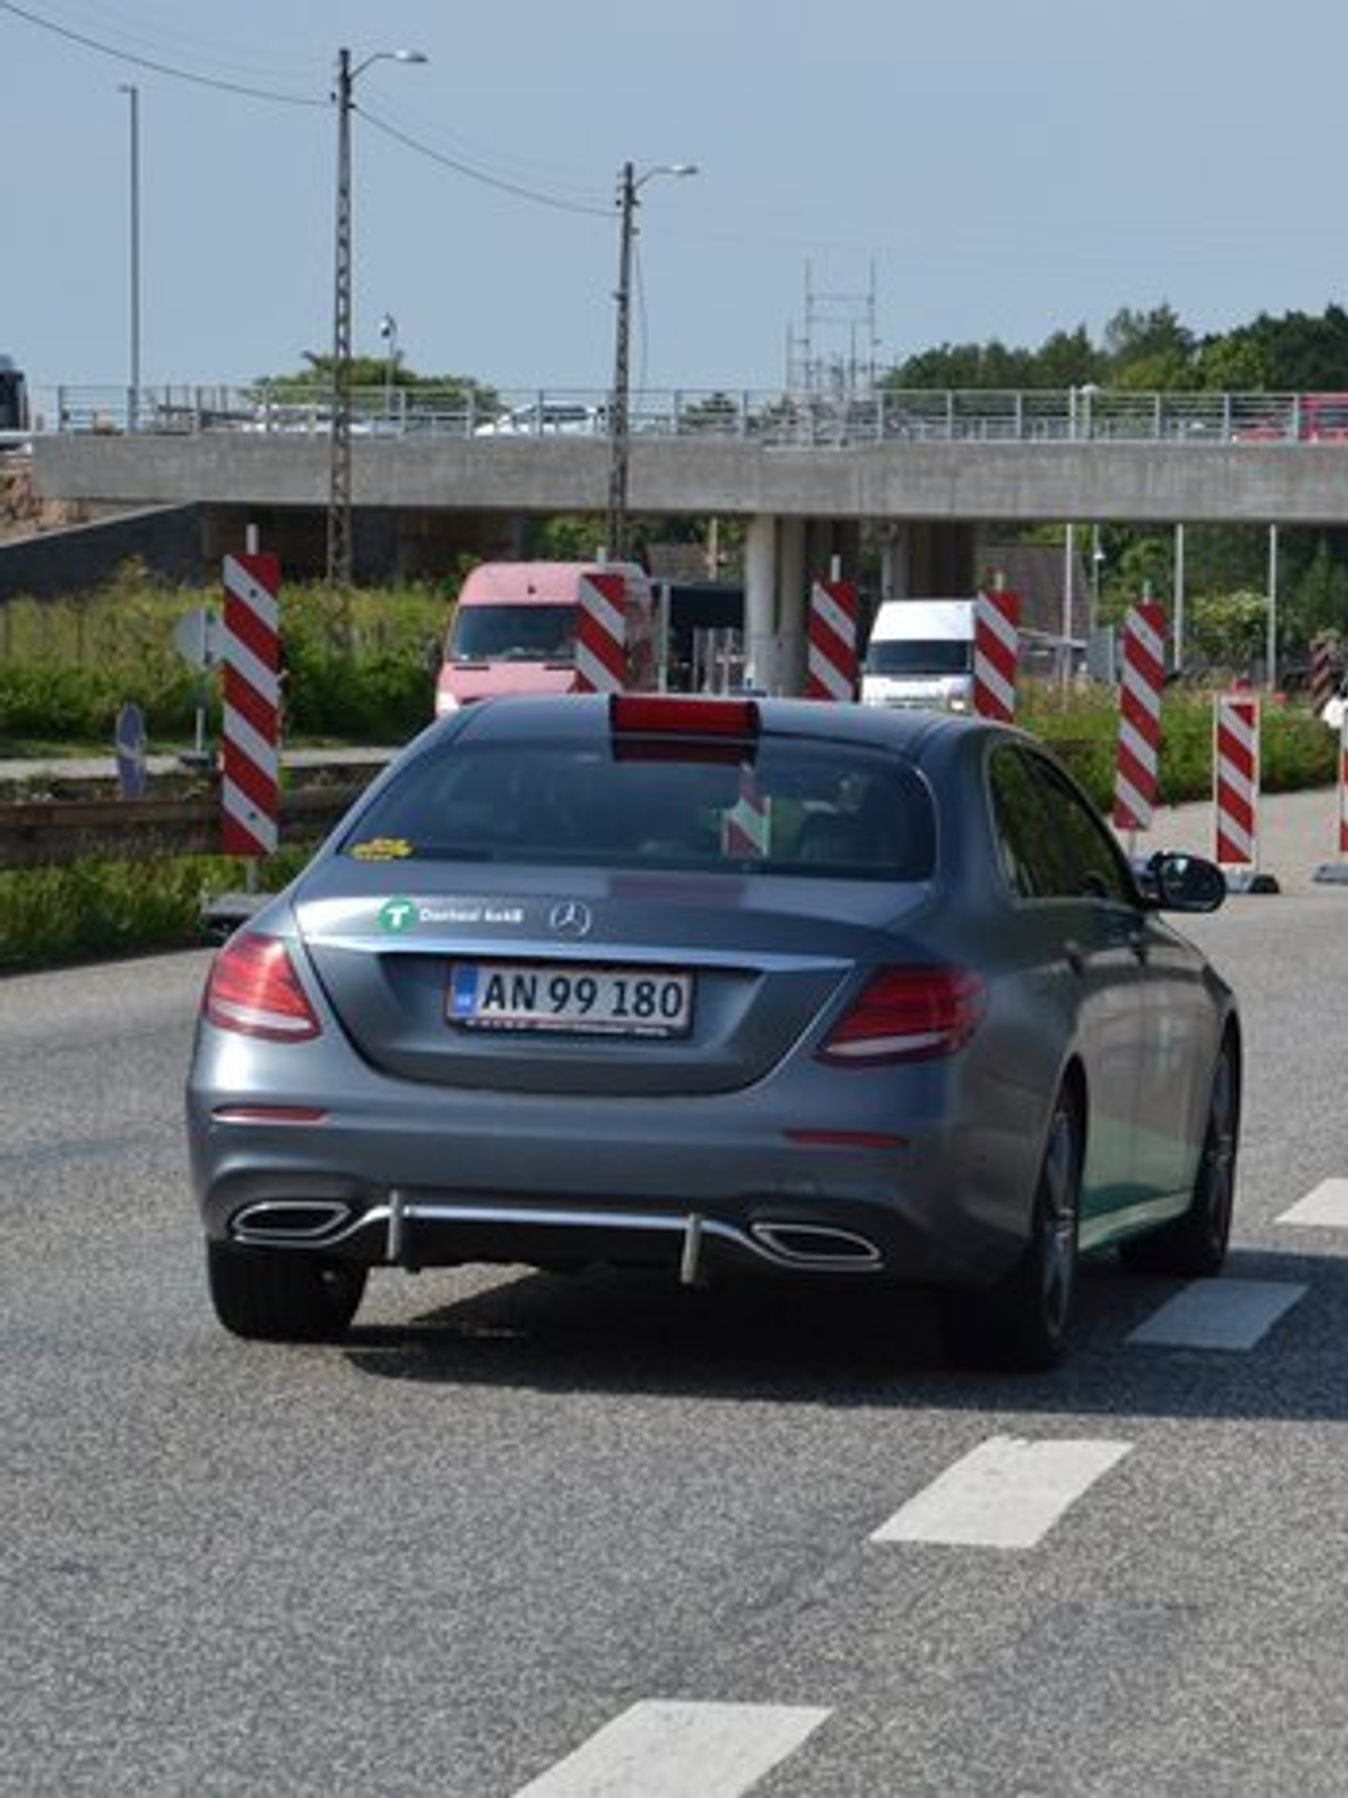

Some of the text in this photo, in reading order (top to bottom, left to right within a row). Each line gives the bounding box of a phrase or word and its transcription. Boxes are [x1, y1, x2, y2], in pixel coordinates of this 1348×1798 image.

[482, 974, 537, 1011] AN
[549, 976, 598, 1014] 99
[611, 981, 684, 1018] 180
